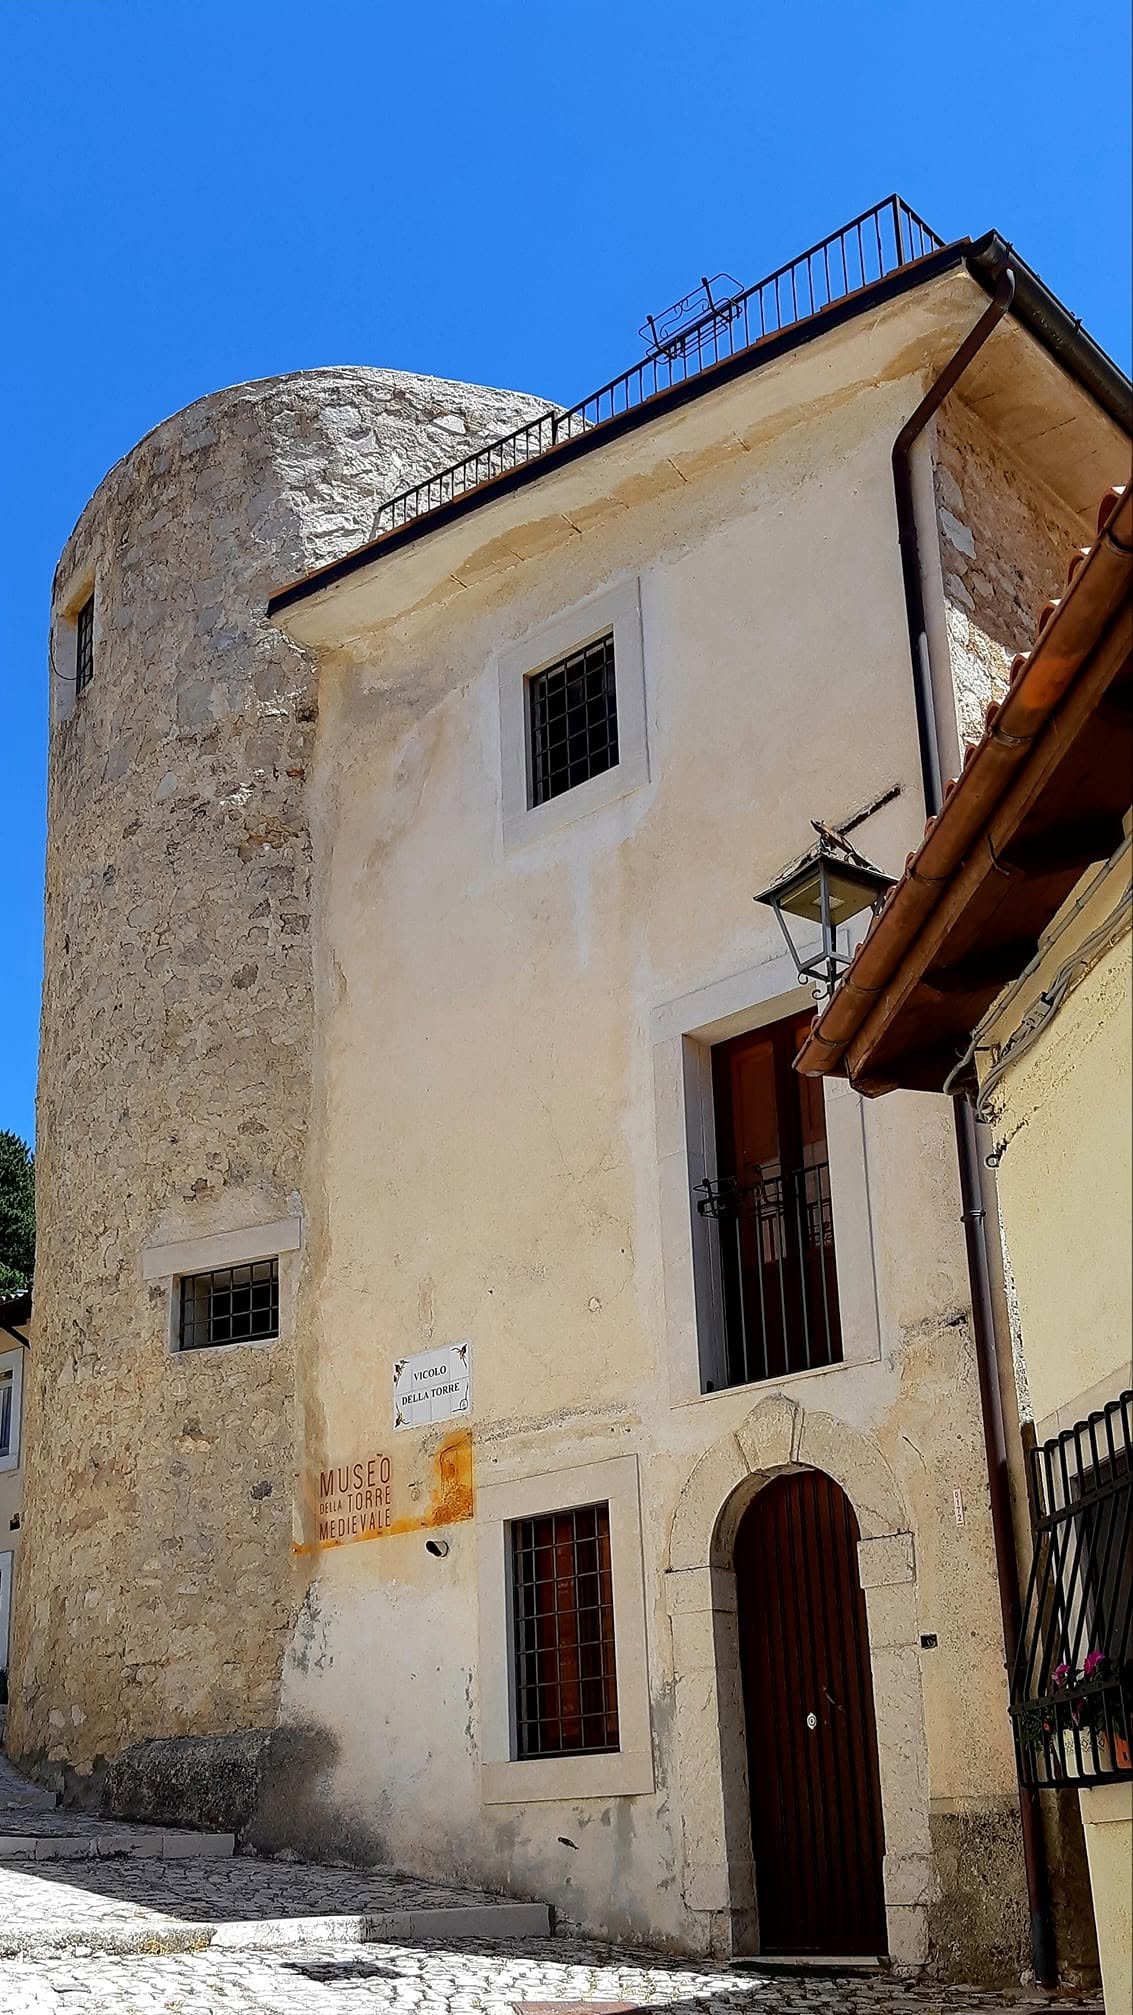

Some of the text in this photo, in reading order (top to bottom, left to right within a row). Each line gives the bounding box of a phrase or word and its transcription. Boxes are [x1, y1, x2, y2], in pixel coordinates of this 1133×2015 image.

[414, 1365, 447, 1381] VICOLO
[401, 1382, 460, 1406] DELLA TORRE
[320, 1457, 391, 1498] MUSEO
[319, 1485, 391, 1515] DELLA TORRE
[319, 1508, 391, 1541] MEDIEVALE
